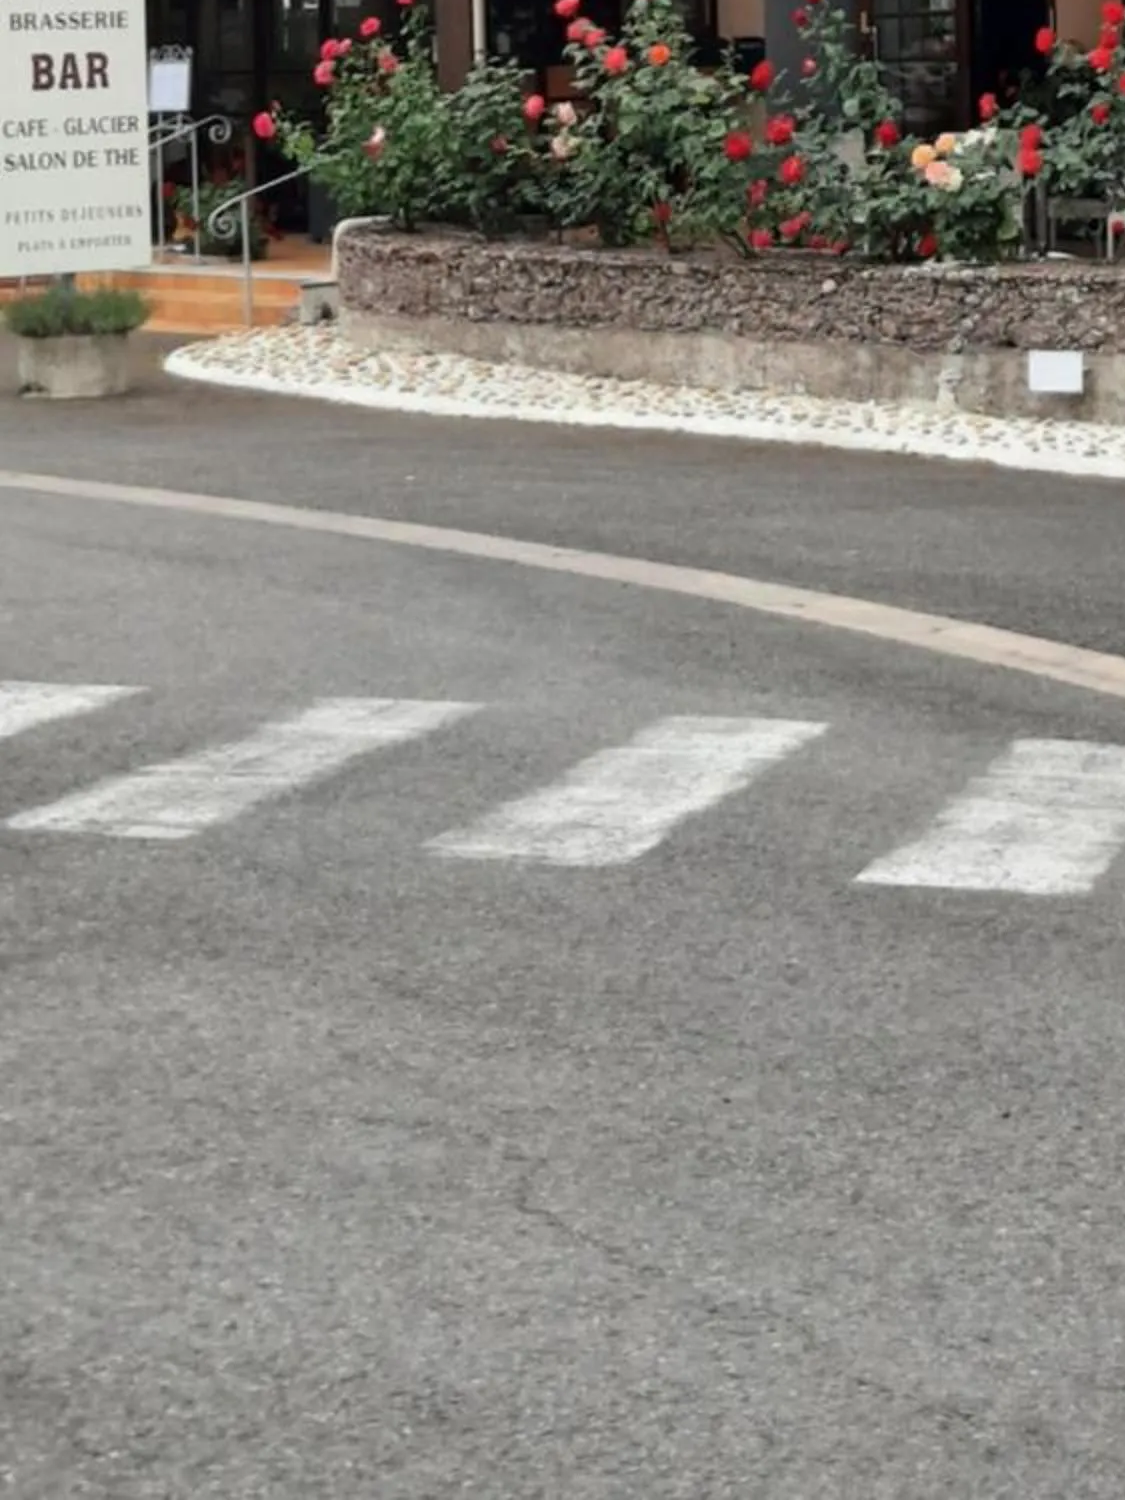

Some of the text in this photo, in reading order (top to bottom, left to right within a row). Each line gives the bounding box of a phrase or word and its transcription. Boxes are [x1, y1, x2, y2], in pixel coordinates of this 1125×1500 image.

[9, 10, 129, 31] BRASSERIE
[31, 52, 110, 91] BAR
[2, 118, 48, 138] CAFE
[63, 115, 139, 136] GLACIER
[3, 147, 141, 173] SALON DE THE
